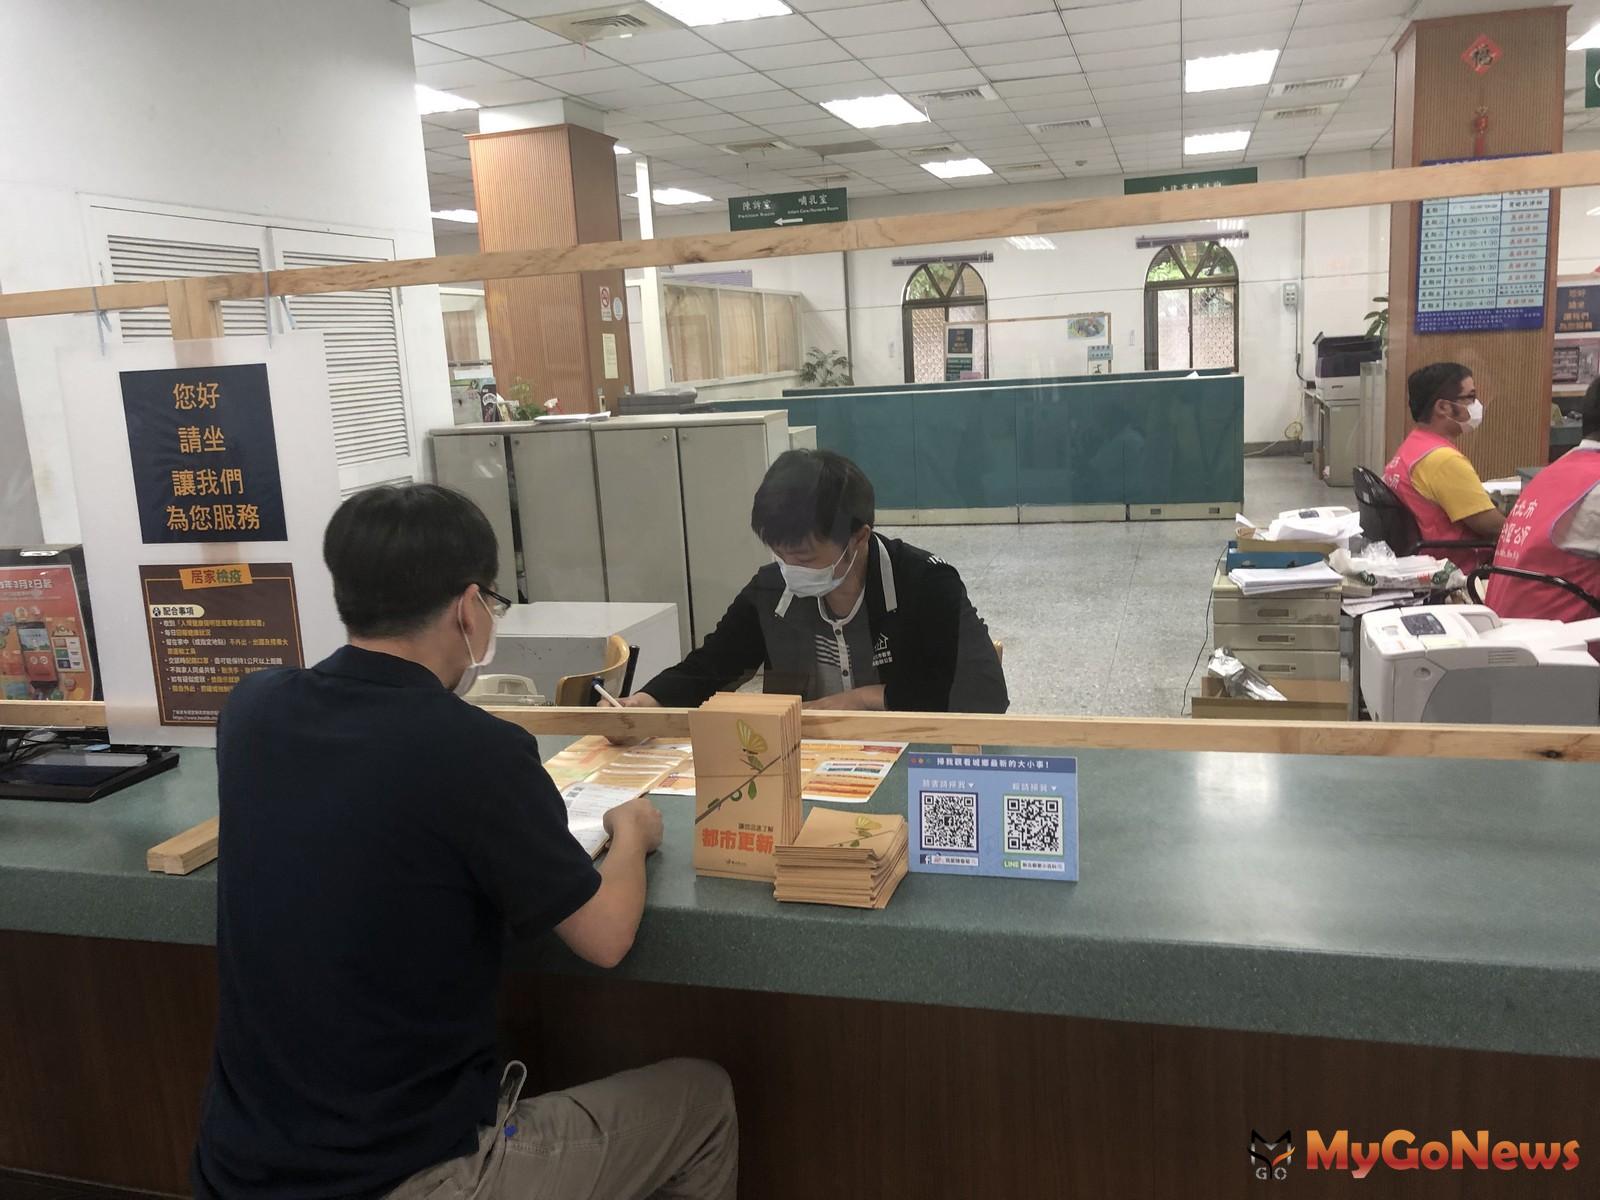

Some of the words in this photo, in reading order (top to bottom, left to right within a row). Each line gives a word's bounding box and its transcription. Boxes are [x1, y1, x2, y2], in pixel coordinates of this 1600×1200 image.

[172, 382, 220, 410] 您好
[178, 425, 226, 454] 請坐
[172, 468, 245, 496] 讓我們
[166, 503, 261, 532] 為您服務
[191, 569, 242, 584] 居家檢疫
[162, 606, 194, 616] 配合事項
[702, 828, 774, 854] 都市更新
